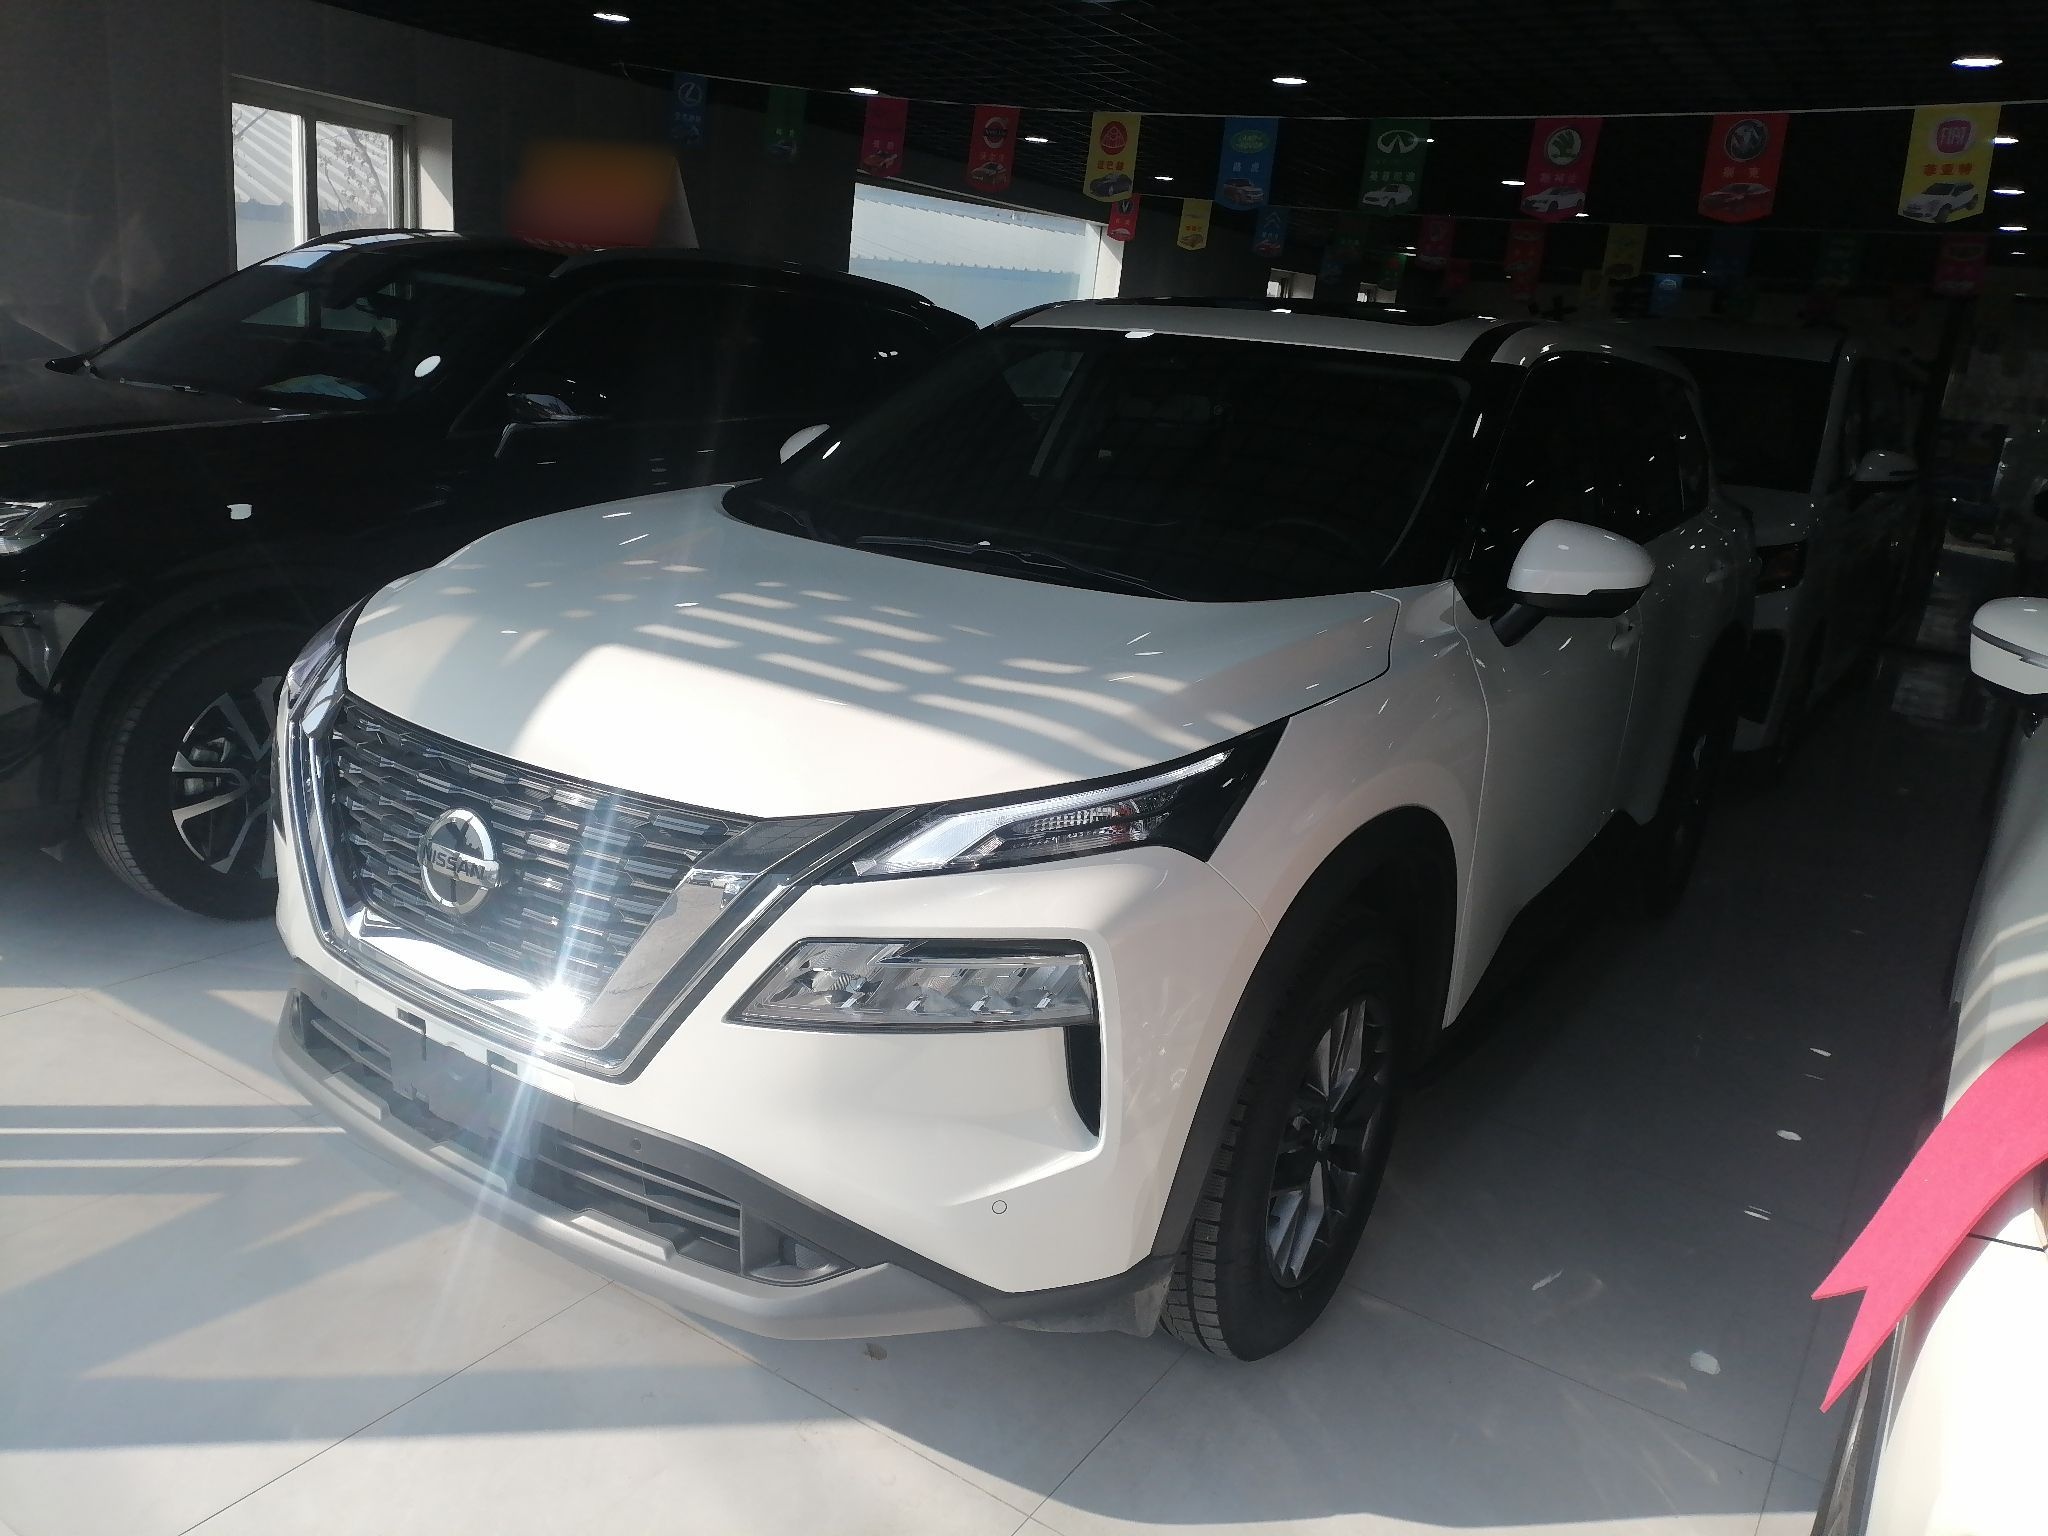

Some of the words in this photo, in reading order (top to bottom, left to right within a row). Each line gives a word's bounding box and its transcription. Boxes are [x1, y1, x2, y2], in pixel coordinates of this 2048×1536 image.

[1923, 162, 1973, 177] 菲亚特
[423, 842, 486, 880] NISSAN
